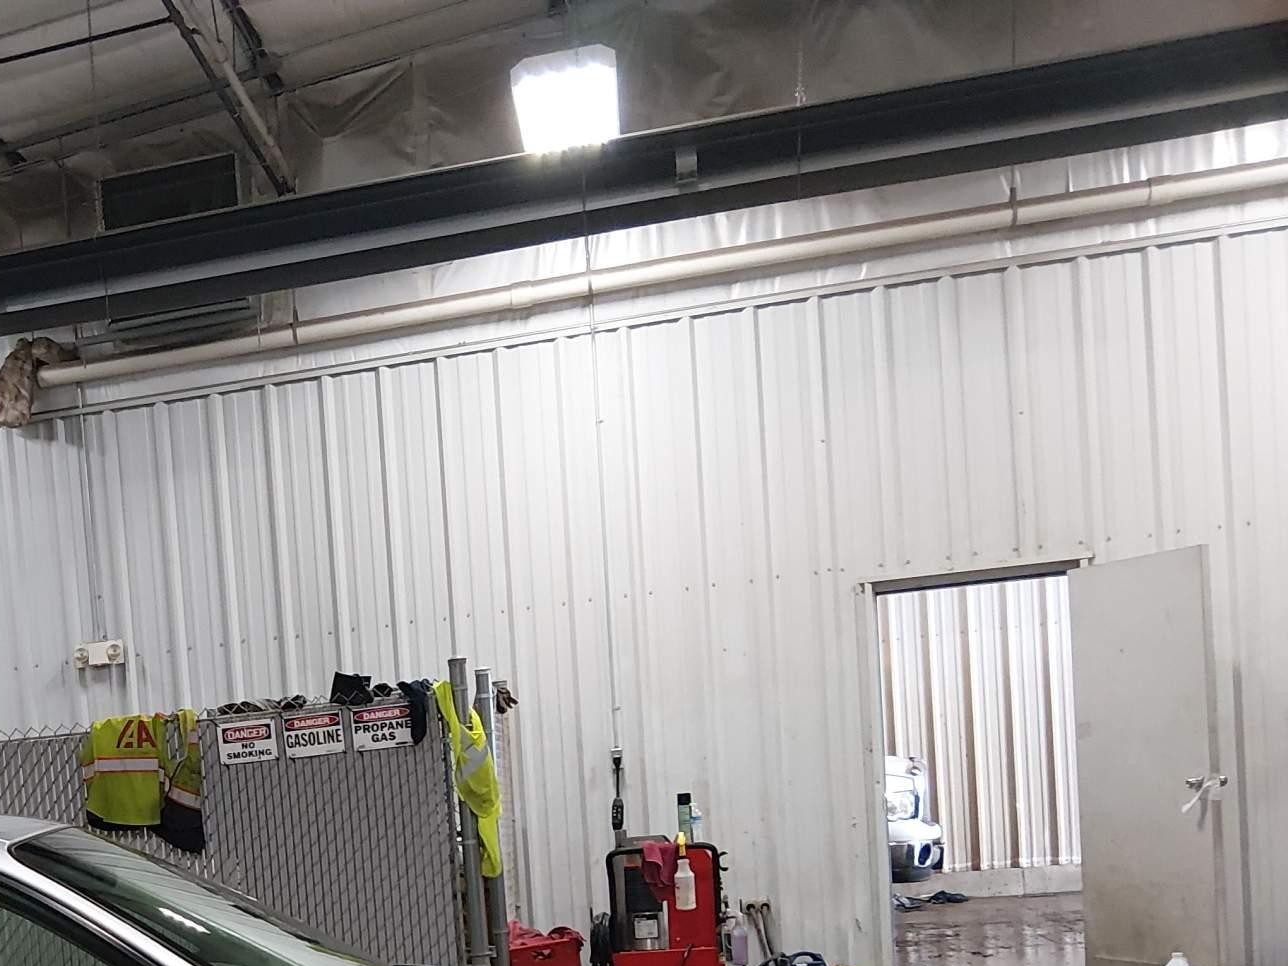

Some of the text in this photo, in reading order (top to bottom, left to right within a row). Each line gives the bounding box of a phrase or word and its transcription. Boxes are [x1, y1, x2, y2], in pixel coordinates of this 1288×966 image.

[362, 708, 401, 720] DANGER
[293, 716, 331, 728] DANGER
[354, 719, 412, 734] PROPANE
[227, 727, 267, 740] DANGER
[286, 728, 343, 749] GASOLINE
[371, 731, 397, 743] GAS
[241, 741, 255, 750] NO
[226, 749, 272, 760] SMOKING
